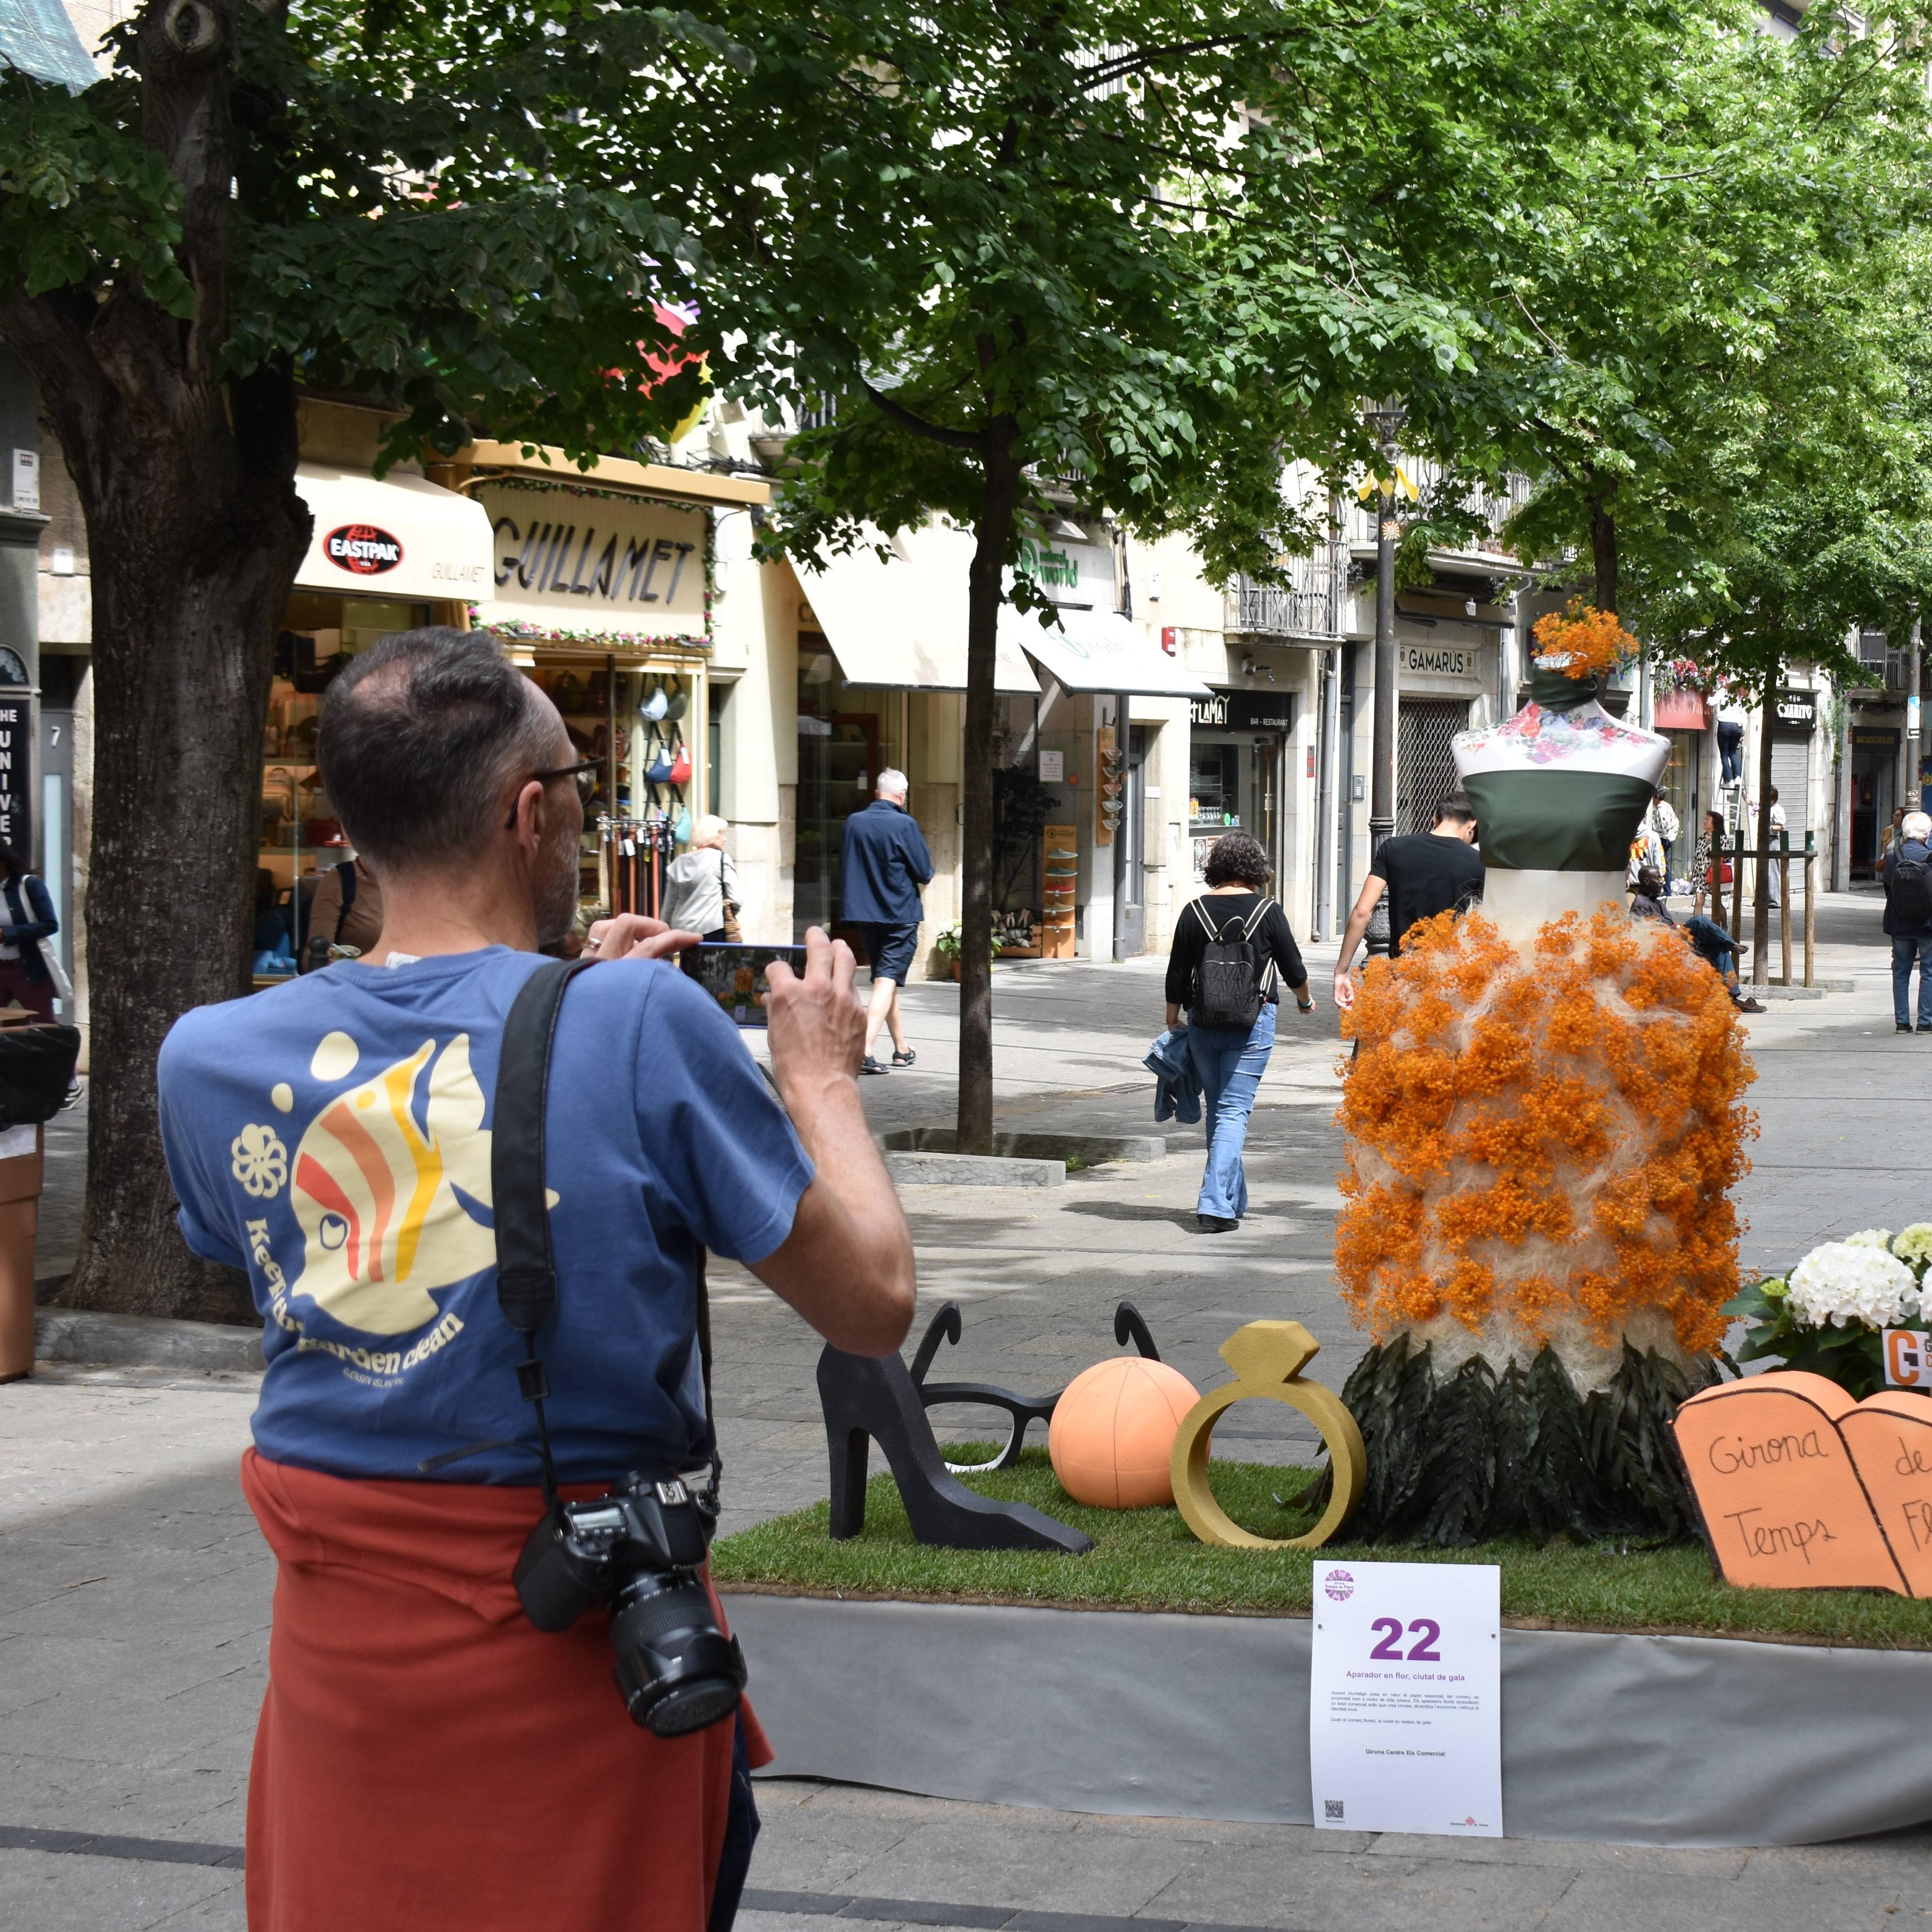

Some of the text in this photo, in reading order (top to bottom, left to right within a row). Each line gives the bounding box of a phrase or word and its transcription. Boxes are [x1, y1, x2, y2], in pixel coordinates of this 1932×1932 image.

[330, 538, 398, 561] EASTPAK
[494, 517, 696, 604] GUILLAMET
[1409, 649, 1463, 673] GAMARÚS
[52, 726, 61, 747] 7
[1263, 718, 1288, 726] RESTAURANT
[403, 1312, 465, 1369] clean
[1709, 1430, 1829, 1474] Girona
[1896, 1436, 1932, 1476] de
[1724, 1507, 1837, 1564] Temps
[1369, 1617, 1441, 1662] 22
[1346, 1671, 1381, 1679] Aparador
[1449, 1674, 1465, 1682] gala
